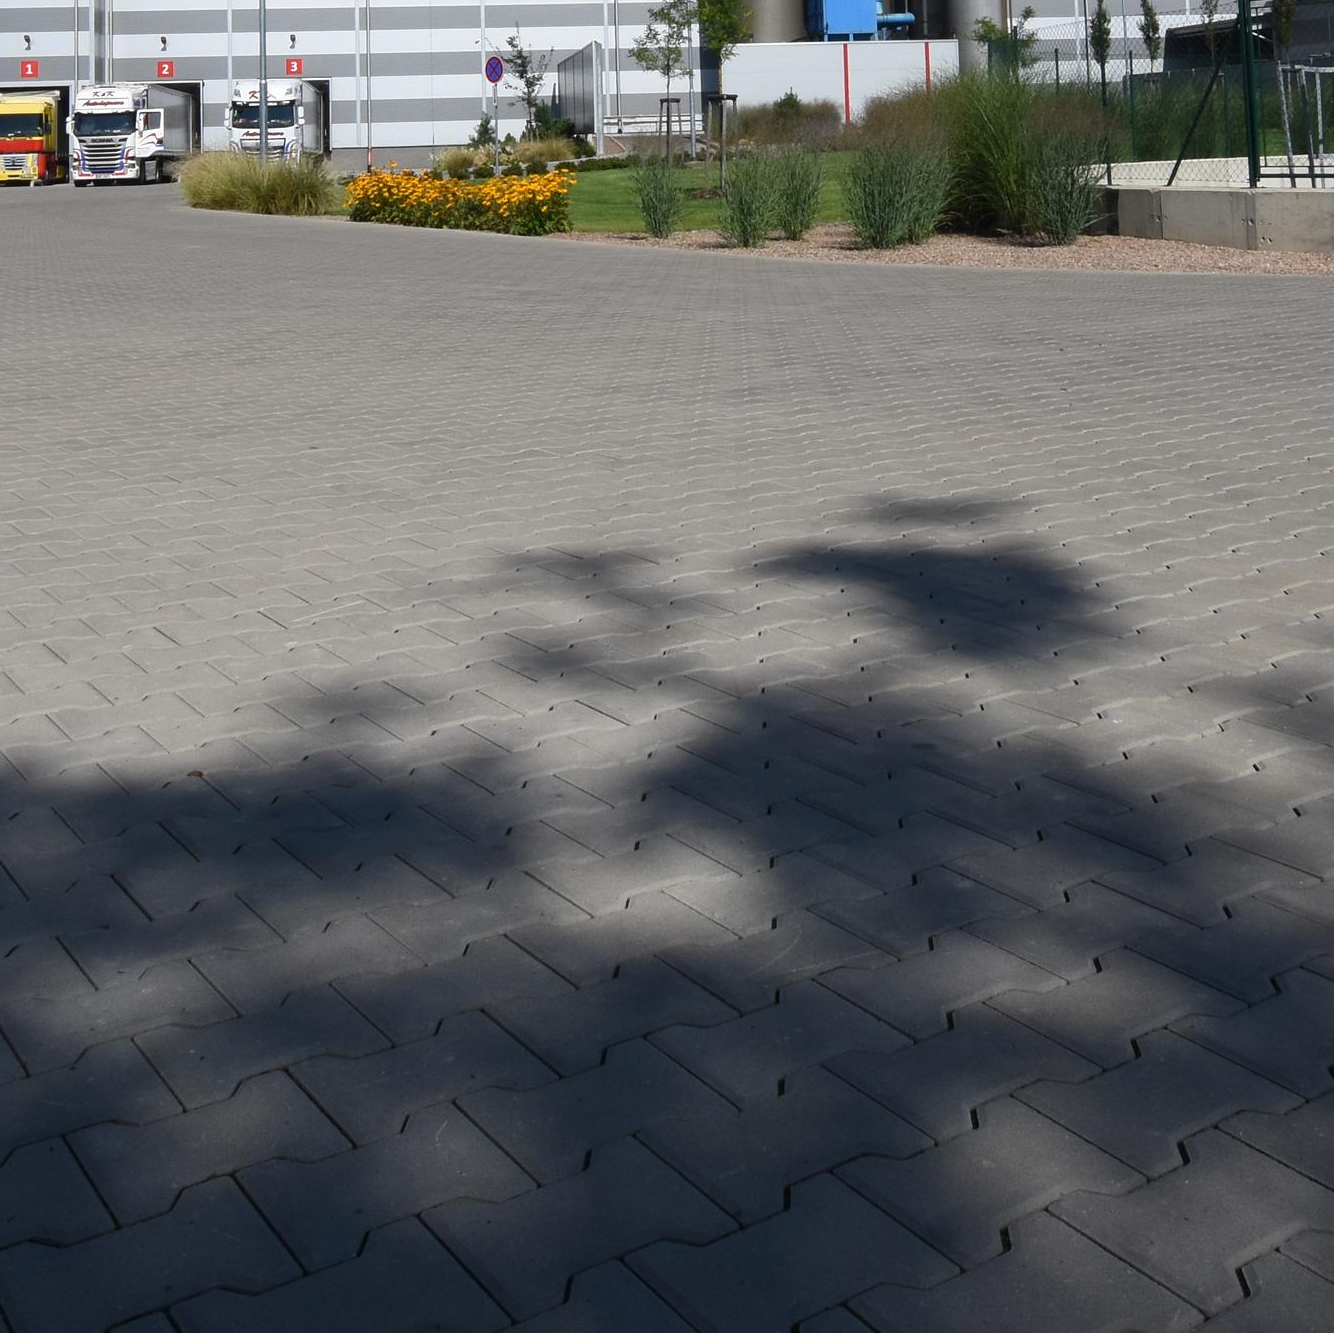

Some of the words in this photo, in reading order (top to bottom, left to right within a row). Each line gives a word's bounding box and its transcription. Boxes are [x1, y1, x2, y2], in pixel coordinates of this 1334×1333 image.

[25, 63, 34, 75] 1
[161, 63, 170, 75] 2
[290, 61, 299, 72] 3
